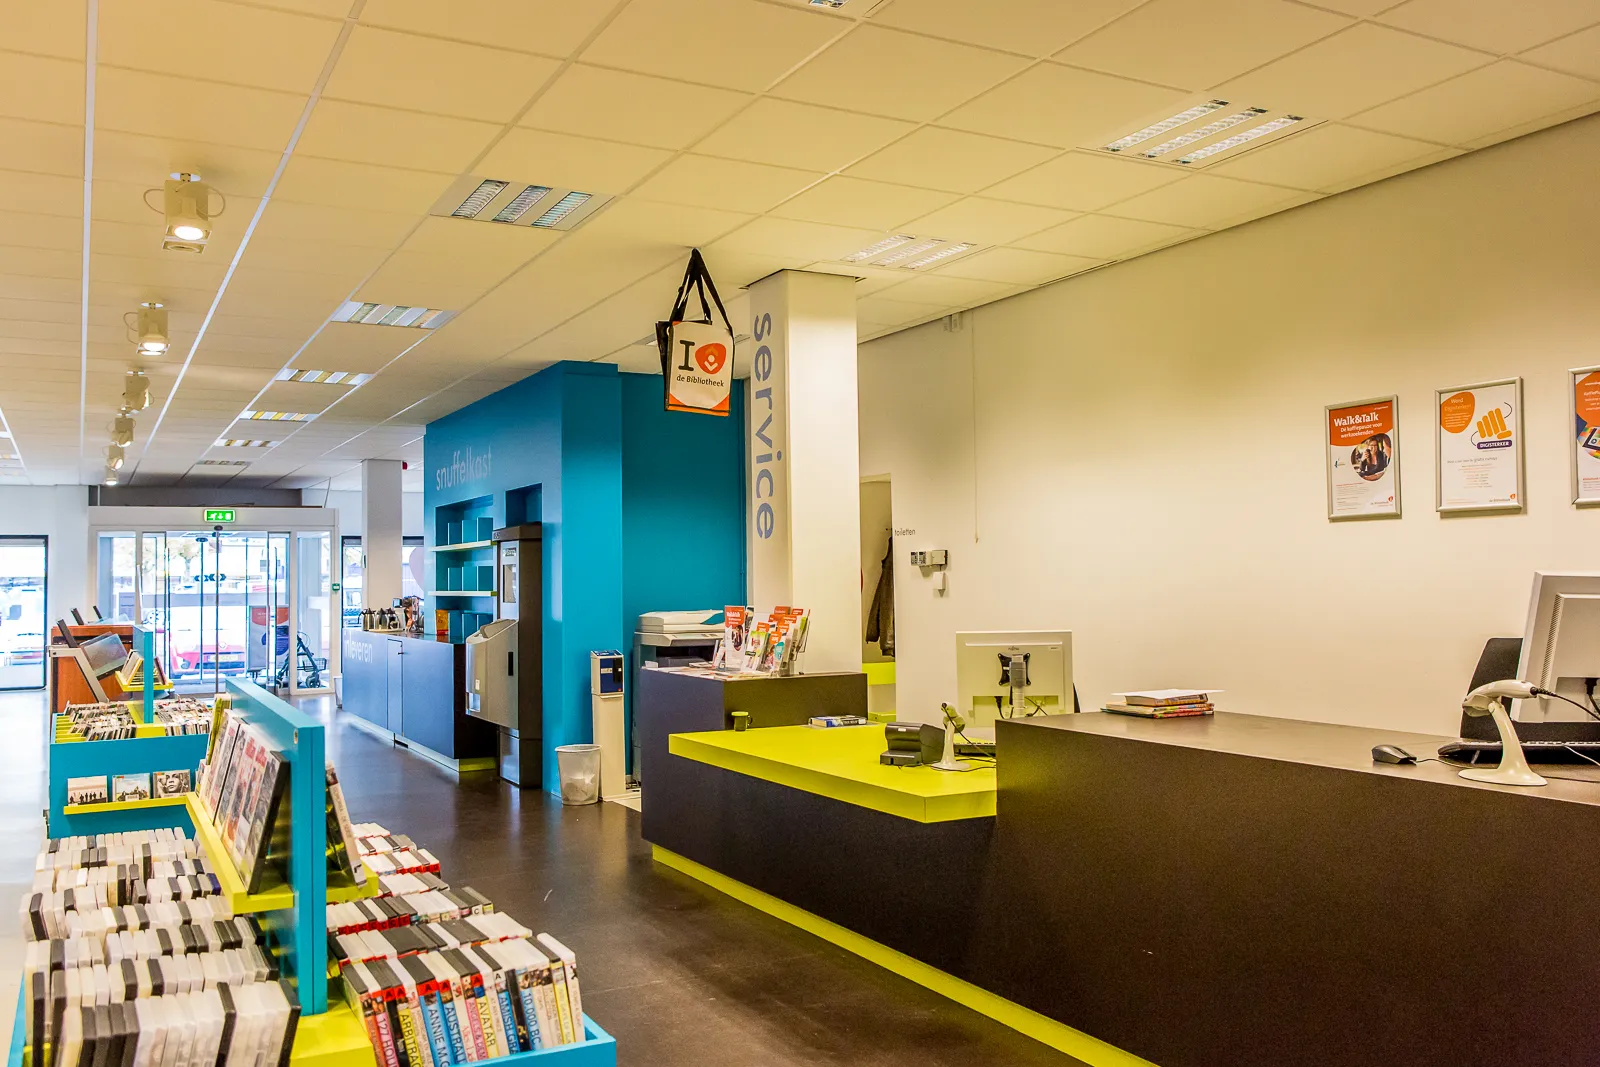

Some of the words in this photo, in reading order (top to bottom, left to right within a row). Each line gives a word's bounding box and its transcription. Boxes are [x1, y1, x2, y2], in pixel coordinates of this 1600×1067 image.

[678, 340, 695, 371] I
[676, 374, 685, 382] de
[686, 376, 725, 387] Bibliotheek
[754, 312, 782, 539] service
[1333, 412, 1379, 427] Walk&Talk
[436, 445, 492, 491] snuffelkast
[894, 528, 916, 536] toiletten
[428, 1009, 445, 1045] ANNIE
[478, 1002, 496, 1047] AVATAR
[500, 997, 512, 1032] AMISH
[383, 1041, 400, 1067] HOU
